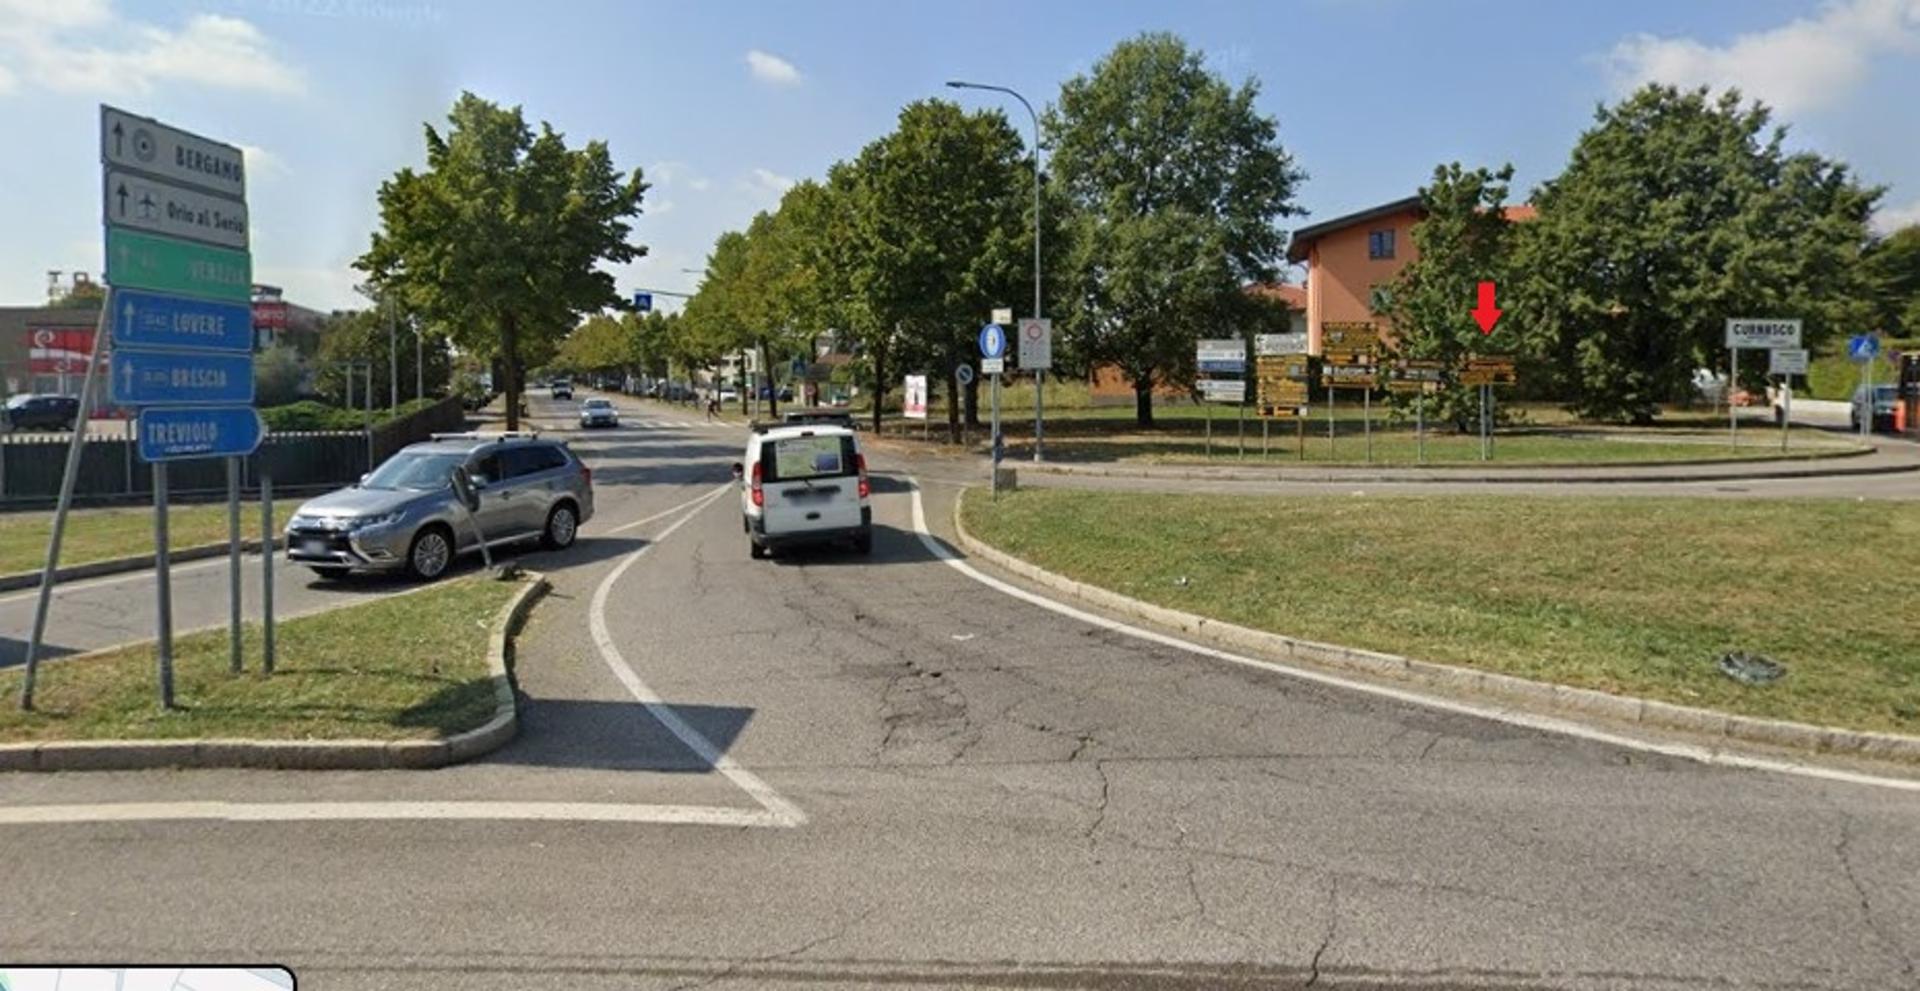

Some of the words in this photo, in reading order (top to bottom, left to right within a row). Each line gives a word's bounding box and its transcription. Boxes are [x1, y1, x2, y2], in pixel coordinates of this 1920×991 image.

[175, 145, 241, 182] BERGAMO
[167, 201, 195, 223] Orio
[197, 209, 211, 227] al
[213, 210, 244, 234] Serio
[173, 311, 225, 336] LOVERE
[171, 368, 227, 388] BRESCIA
[147, 421, 218, 445] TREVIOLO
